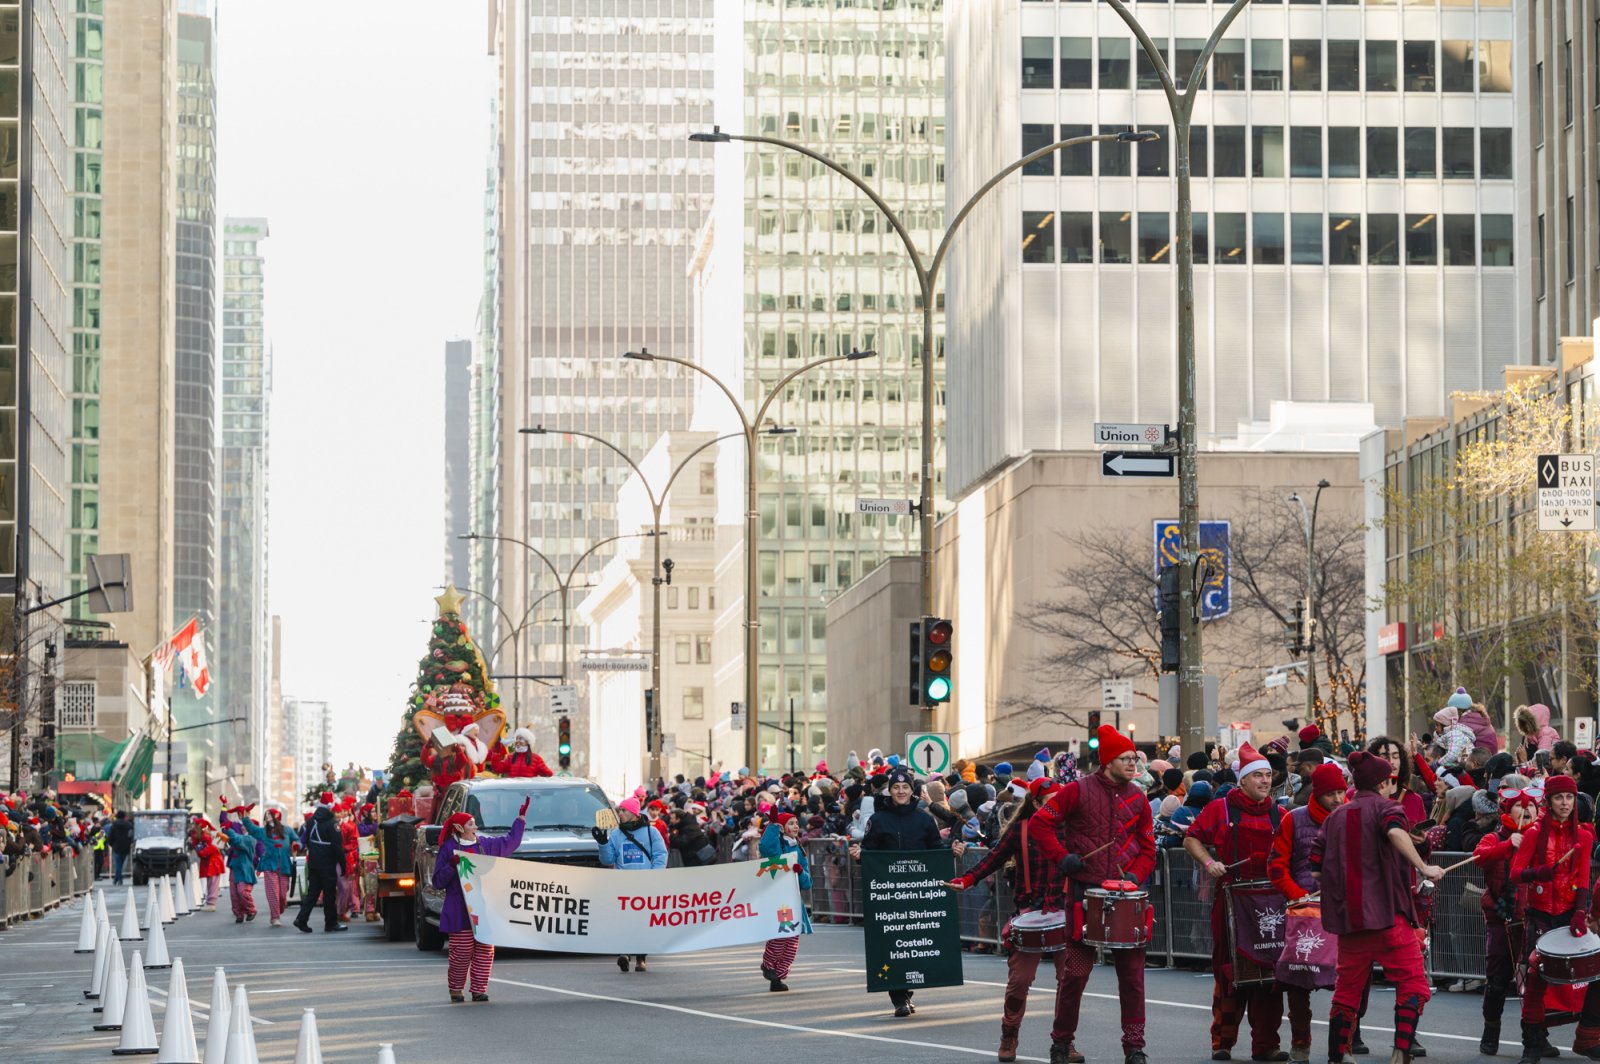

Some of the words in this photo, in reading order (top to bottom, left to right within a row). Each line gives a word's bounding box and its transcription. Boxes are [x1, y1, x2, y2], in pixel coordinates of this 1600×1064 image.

[1100, 430, 1139, 441] Union
[1561, 461, 1591, 472] BUS
[1561, 476, 1592, 487] TAXI
[860, 503, 890, 512] Union
[1544, 509, 1560, 517] LUN
[1572, 509, 1589, 517] VEN
[510, 879, 571, 895] MONTRÉAL
[870, 879, 895, 890] École
[896, 878, 945, 889] secondaire
[870, 890, 918, 901] Paul-Gérin
[919, 888, 947, 900] Lajoie
[509, 892, 590, 916] CENTRE
[875, 910, 908, 922] Hôpital
[908, 909, 947, 919] Shriners
[883, 924, 905, 933] pour
[905, 921, 941, 931] enfants
[895, 938, 933, 948] Costello
[1253, 941, 1285, 950] KUMPA'NI
[890, 950, 910, 960] Irish
[911, 949, 941, 958] Dance
